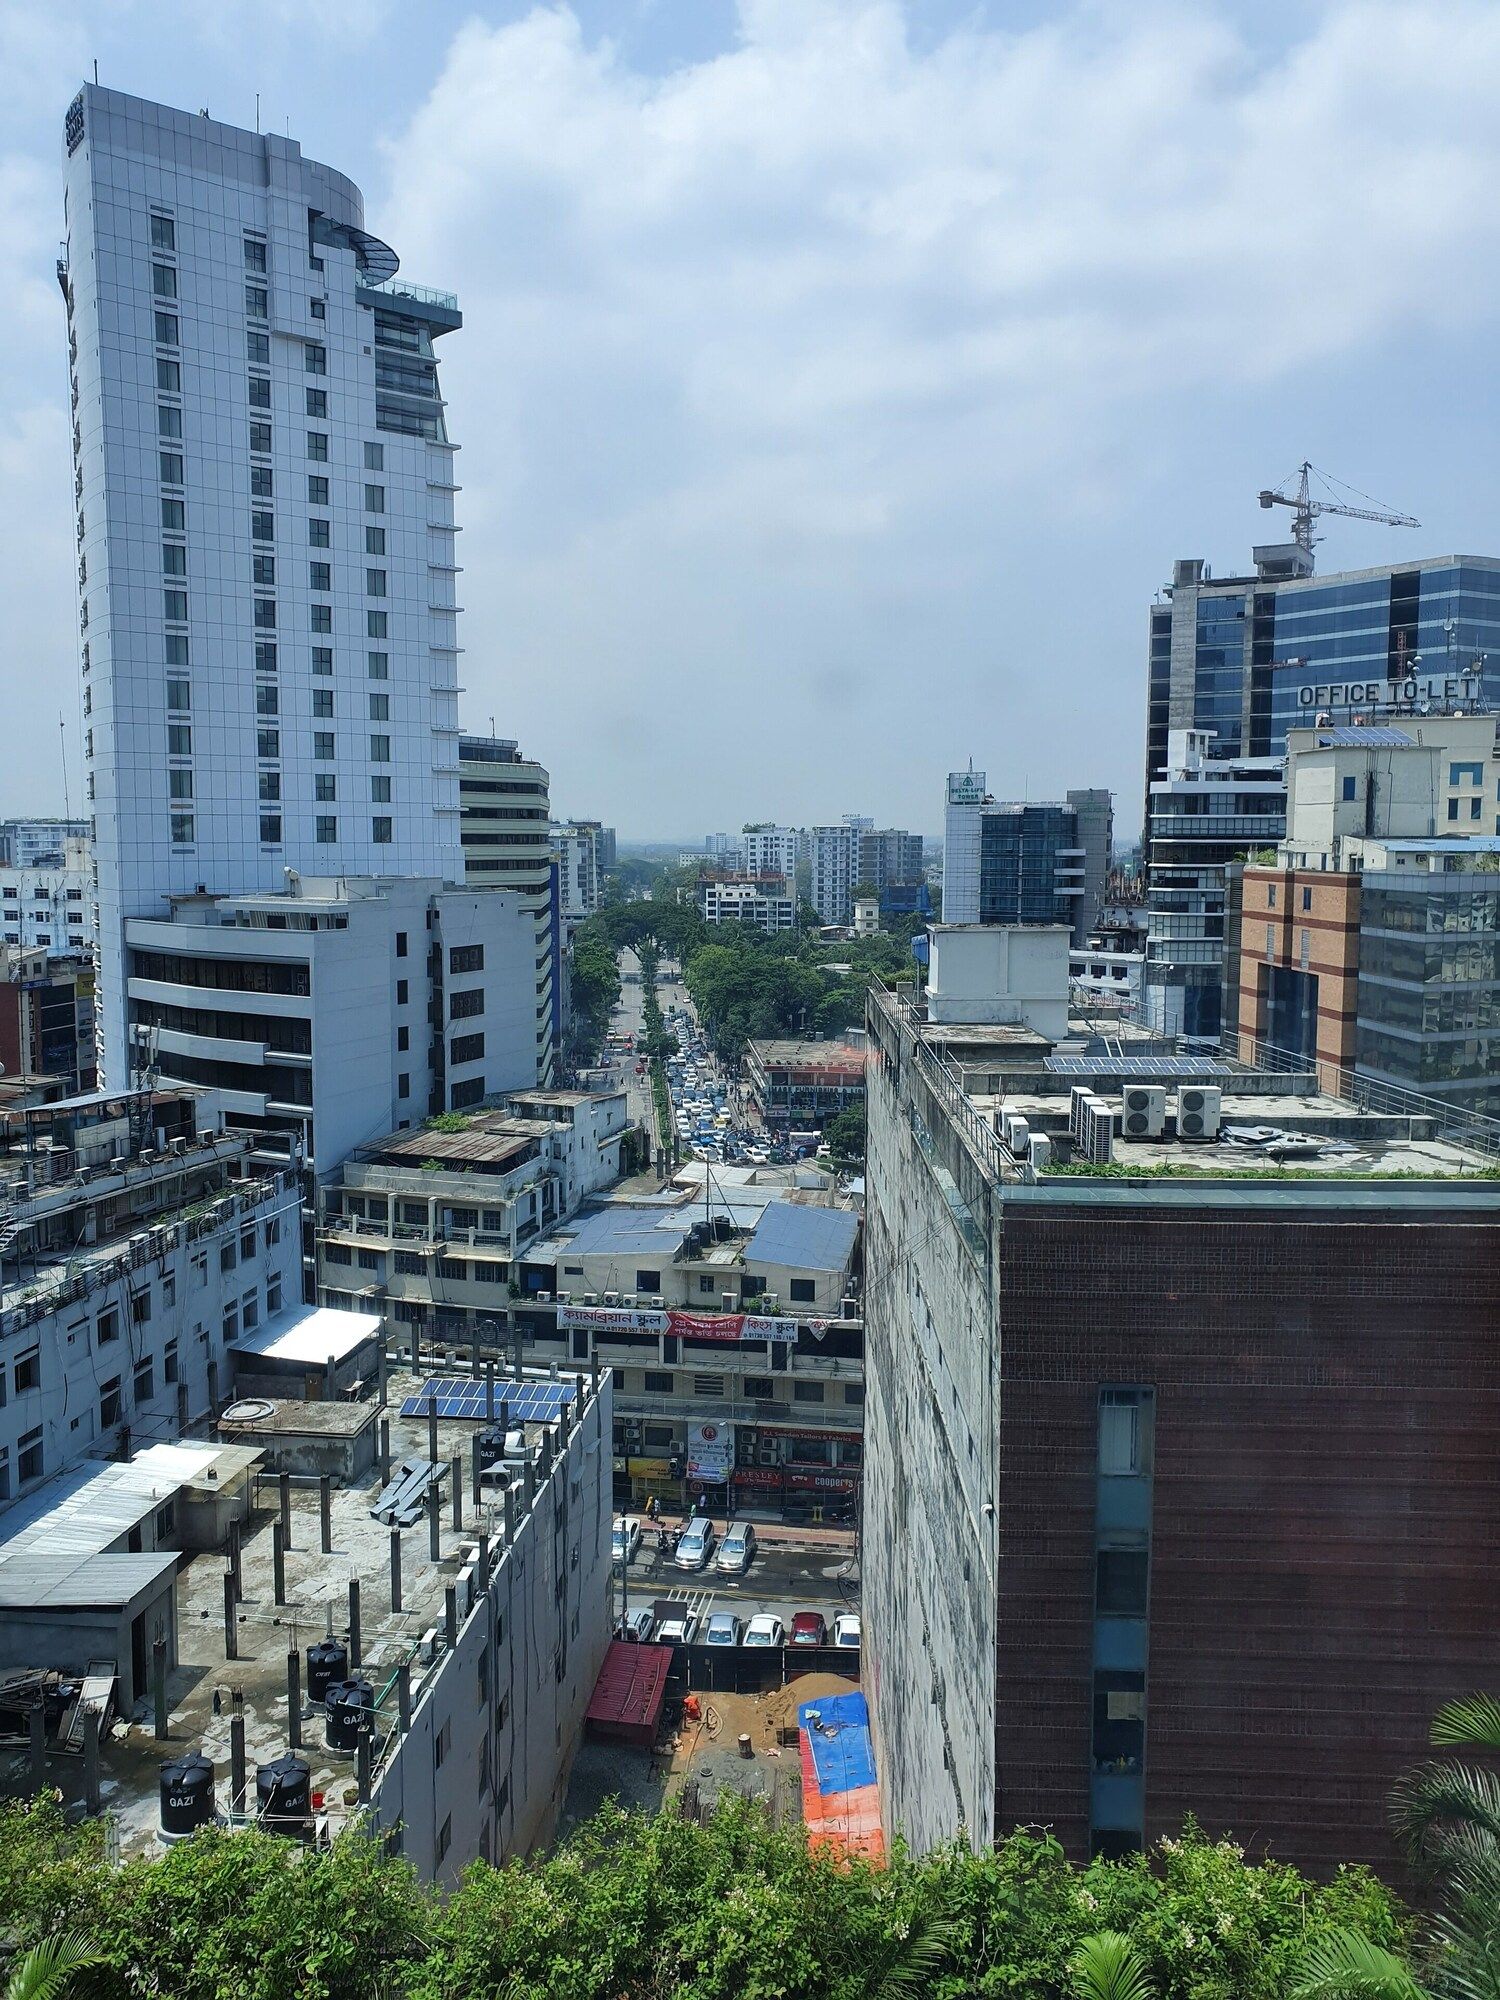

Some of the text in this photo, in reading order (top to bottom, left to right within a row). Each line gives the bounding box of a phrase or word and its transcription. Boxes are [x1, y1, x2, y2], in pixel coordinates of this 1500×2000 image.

[1300, 678, 1475, 705] OFFICE TO-LET
[563, 1308, 661, 1328] ক্যামব্রিয়ান স্কুল
[748, 1317, 795, 1334] কিংস স্কুল
[695, 1329, 712, 1337] ভর্তি
[735, 1471, 781, 1480] PRESLEY
[343, 1710, 366, 1726] GAZI
[169, 1794, 196, 1808] GAZI
